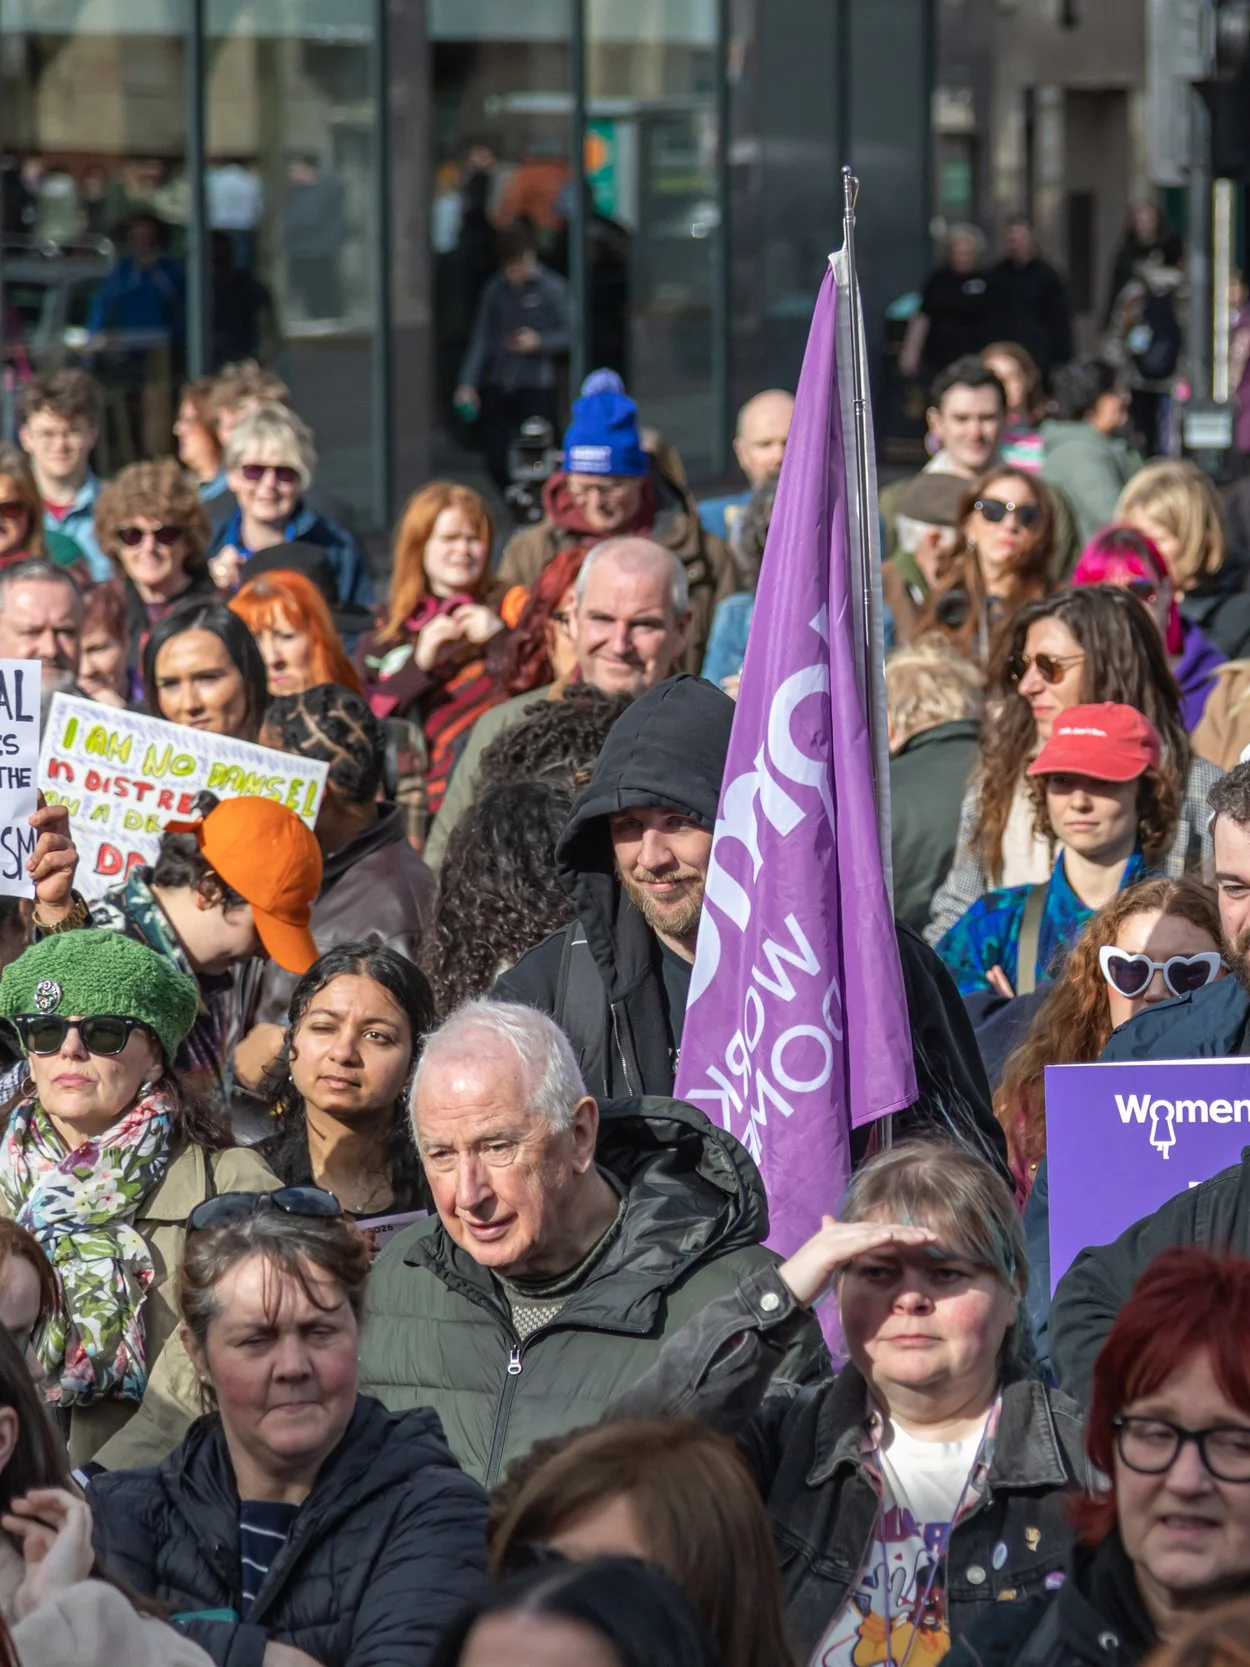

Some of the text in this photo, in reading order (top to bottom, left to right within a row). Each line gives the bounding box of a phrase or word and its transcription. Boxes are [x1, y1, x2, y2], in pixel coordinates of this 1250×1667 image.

[62, 717, 318, 817] I AM NO DAMSEL
[89, 803, 111, 824] A
